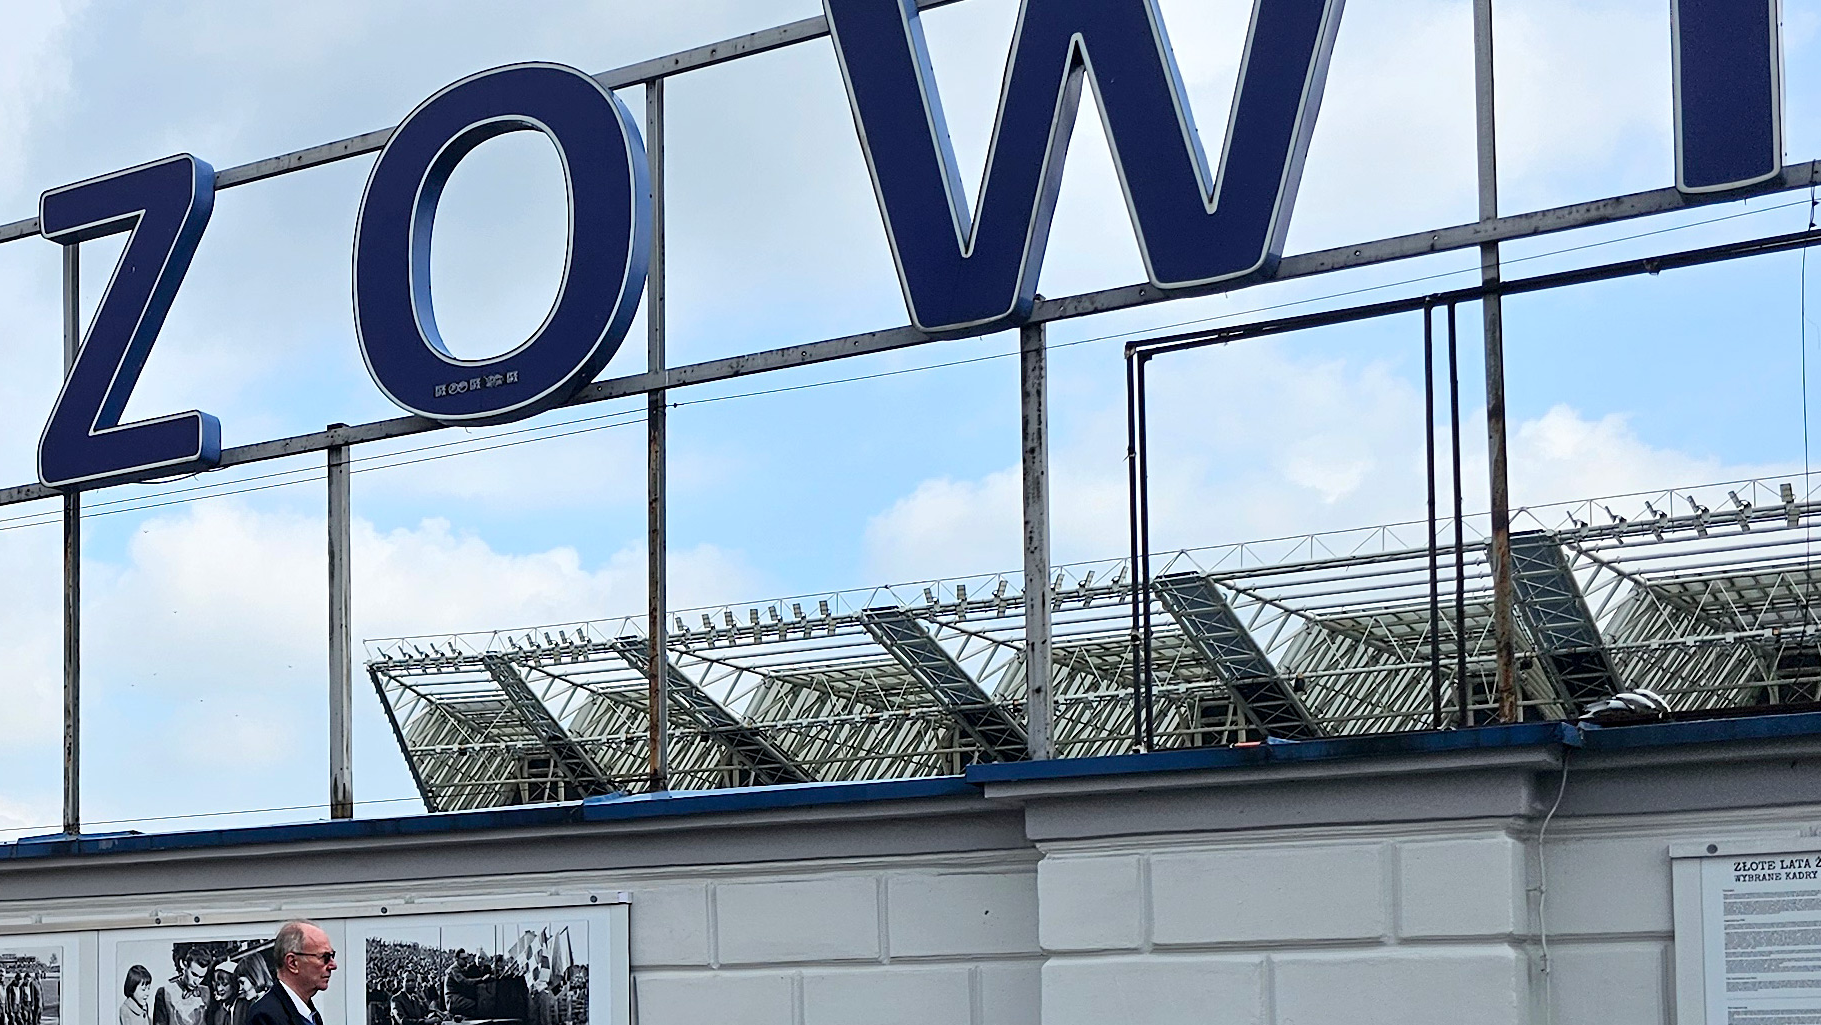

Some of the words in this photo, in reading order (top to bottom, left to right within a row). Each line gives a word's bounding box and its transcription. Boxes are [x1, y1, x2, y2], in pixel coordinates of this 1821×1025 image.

[1734, 861, 1776, 872] ZŁOTE
[1780, 859, 1812, 870] LATA
[1734, 873, 1782, 883] WYBRANE
[1785, 870, 1819, 881] KADRY
